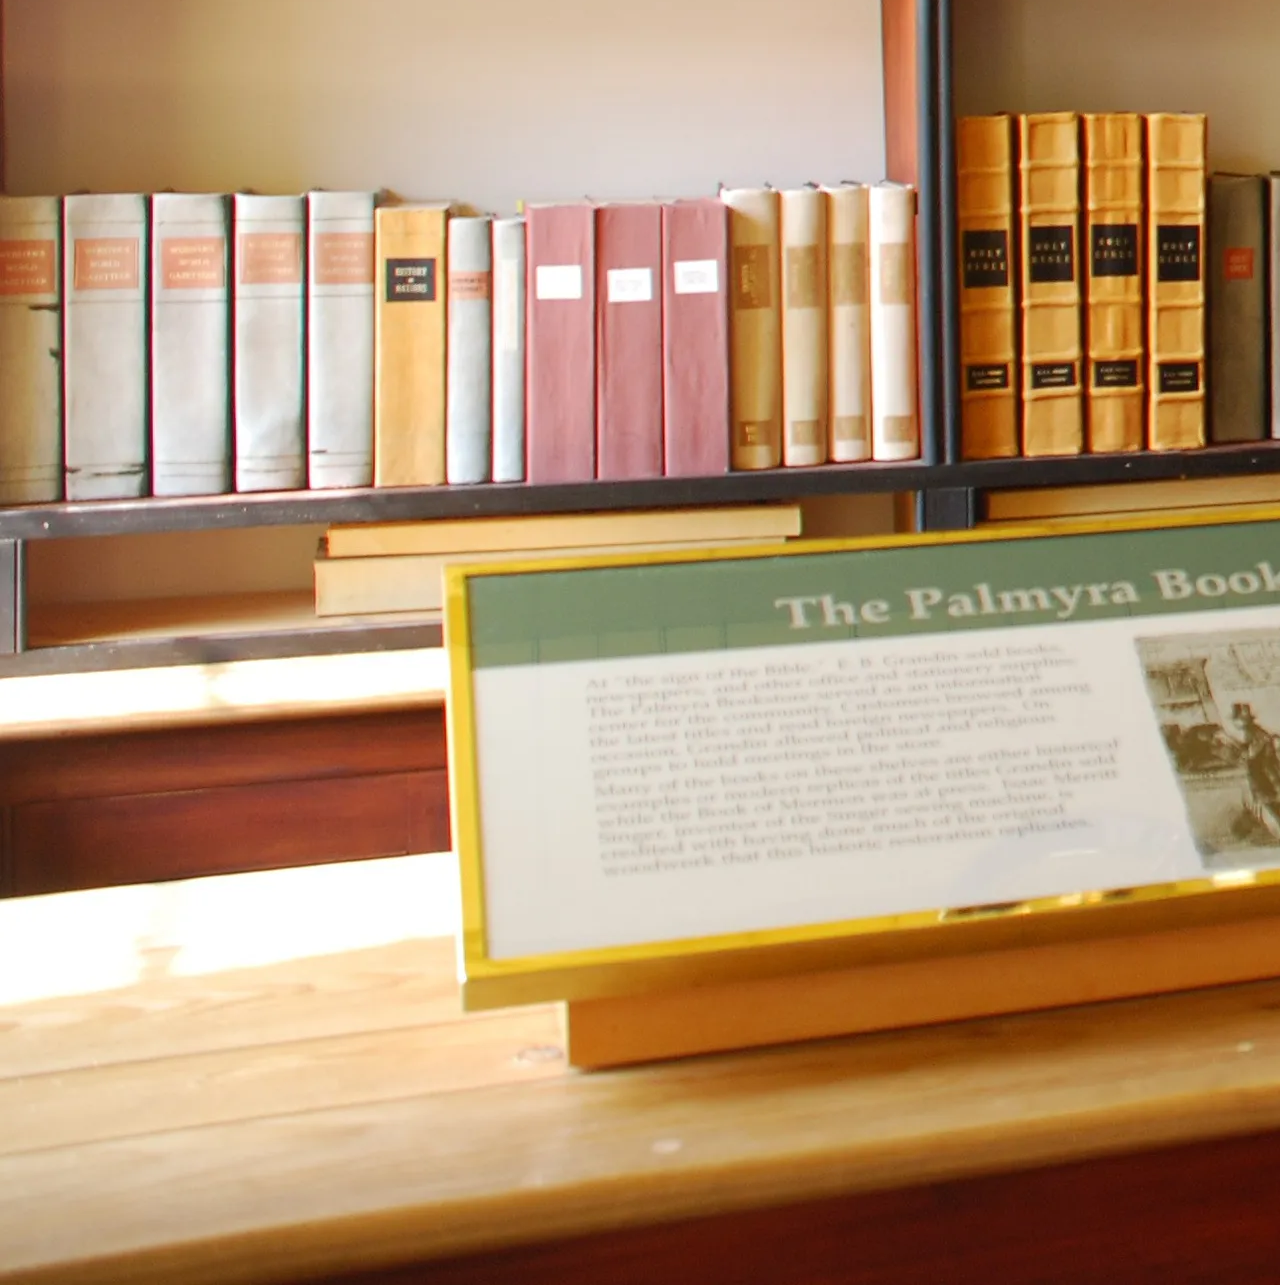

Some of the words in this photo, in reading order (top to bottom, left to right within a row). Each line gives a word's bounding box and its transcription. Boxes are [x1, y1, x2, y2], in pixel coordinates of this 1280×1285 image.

[774, 593, 891, 630] The
[905, 575, 1140, 620] Palmyra
[586, 677, 607, 689] At
[660, 670, 699, 686] sign
[705, 668, 724, 679] of
[729, 665, 758, 677] the
[881, 649, 958, 665] Grandin
[964, 646, 1001, 659] sold
[712, 680, 749, 693] and
[753, 676, 802, 690] other
[807, 672, 859, 686] office
[864, 668, 899, 681] and
[904, 661, 994, 681] stationery
[587, 717, 648, 733] center
[654, 715, 681, 727] for
[687, 712, 718, 724] the
[839, 693, 940, 712] Customers
[944, 686, 1024, 703] browsed
[1029, 684, 1091, 699] among
[589, 705, 624, 718] The
[629, 698, 711, 717] Palmyra
[715, 690, 810, 707] Bookstore
[815, 684, 878, 699] served
[882, 685, 902, 694] as
[906, 683, 929, 692] an
[933, 671, 1042, 689] information
[589, 734, 618, 747] the
[626, 729, 677, 744] latest
[684, 725, 729, 739] titles
[738, 721, 772, 734] and
[778, 717, 819, 731] read
[825, 711, 891, 730] foreign
[1021, 698, 1050, 710] On
[685, 737, 767, 754] Grandin
[774, 730, 850, 746] allowed
[855, 723, 932, 742] political
[935, 719, 972, 732] and
[976, 712, 1057, 732] religious
[591, 764, 664, 780] groups
[666, 758, 689, 771] to
[691, 754, 740, 769] hold
[742, 746, 833, 767] meetings
[834, 744, 857, 756] in
[859, 741, 891, 754] the
[594, 780, 651, 799] Many
[657, 778, 679, 790] of
[683, 774, 715, 788] the
[719, 769, 779, 785] books
[783, 769, 808, 779] on
[813, 761, 863, 776] these
[868, 755, 939, 771] shelves
[943, 755, 973, 765] are
[976, 747, 1031, 762] either
[1035, 739, 1121, 756] historical
[594, 791, 691, 814] examples
[696, 793, 716, 802] or
[723, 782, 800, 799] modern
[806, 774, 881, 795] replicas
[884, 772, 905, 785] of
[909, 769, 939, 782] the
[944, 765, 991, 779] titles
[994, 757, 1073, 775] Grandin
[1077, 753, 1117, 767] sold
[595, 810, 656, 827] while
[658, 807, 692, 821] the
[695, 802, 749, 818] Book
[750, 799, 775, 812] of
[778, 791, 867, 810] Mormon
[868, 791, 910, 802] was
[911, 785, 934, 798] at
[999, 775, 1049, 789] Isaac
[1051, 768, 1121, 785] Merritt
[672, 817, 761, 836] inventor
[762, 814, 786, 827] of
[788, 811, 822, 825] the
[825, 805, 890, 824] Singer
[892, 798, 965, 818] sewing
[1056, 787, 1074, 800] is
[599, 840, 685, 859] credited
[691, 835, 736, 850] with
[741, 828, 811, 848] having
[817, 823, 866, 838] done
[871, 817, 927, 833] much
[931, 814, 952, 827] of
[956, 811, 986, 825] the
[990, 804, 1067, 824] original
[602, 853, 715, 875] woodwork
[720, 849, 760, 864] that
[765, 845, 803, 859] this
[808, 837, 882, 855] historic
[887, 826, 993, 847] restoration
